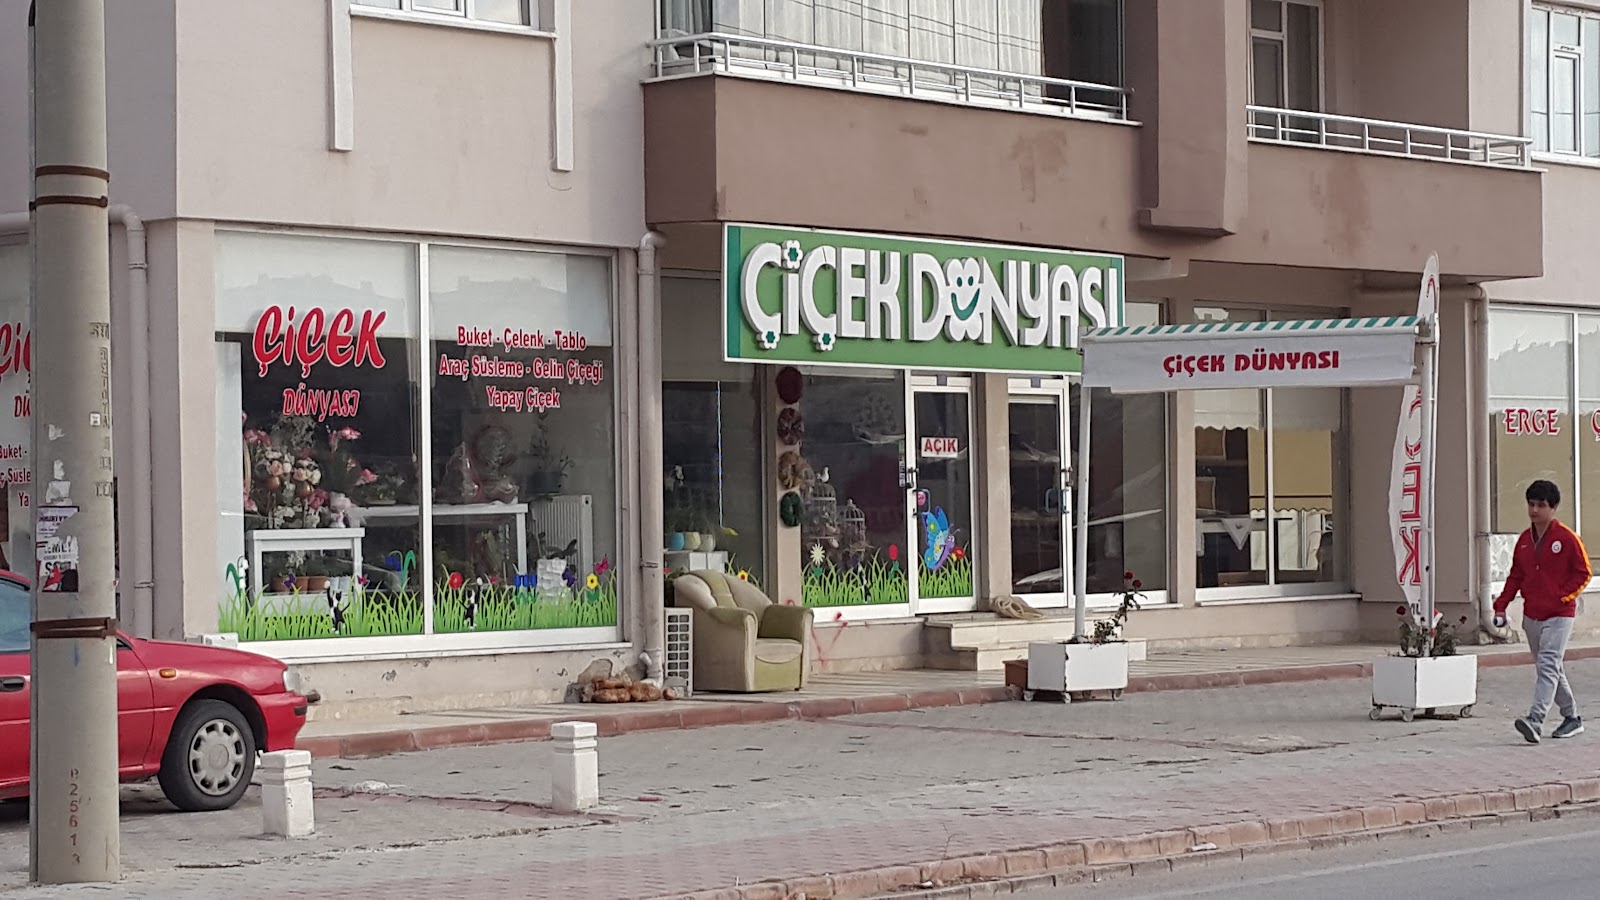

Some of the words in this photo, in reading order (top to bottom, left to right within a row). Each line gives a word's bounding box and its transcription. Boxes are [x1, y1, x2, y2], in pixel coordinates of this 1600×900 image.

[457, 325, 493, 346] Buket
[504, 327, 544, 352] Çelenk
[554, 330, 586, 350] Tablo
[440, 354, 469, 381] Araç
[472, 355, 523, 377] Süsleme
[533, 356, 564, 379] Gelin
[1234, 347, 1339, 372] DÜNYASI
[486, 385, 523, 412] Yapay
[525, 385, 560, 412] Çiçek
[924, 438, 956, 455] AÇIK
[7, 467, 31, 483] Süsle
